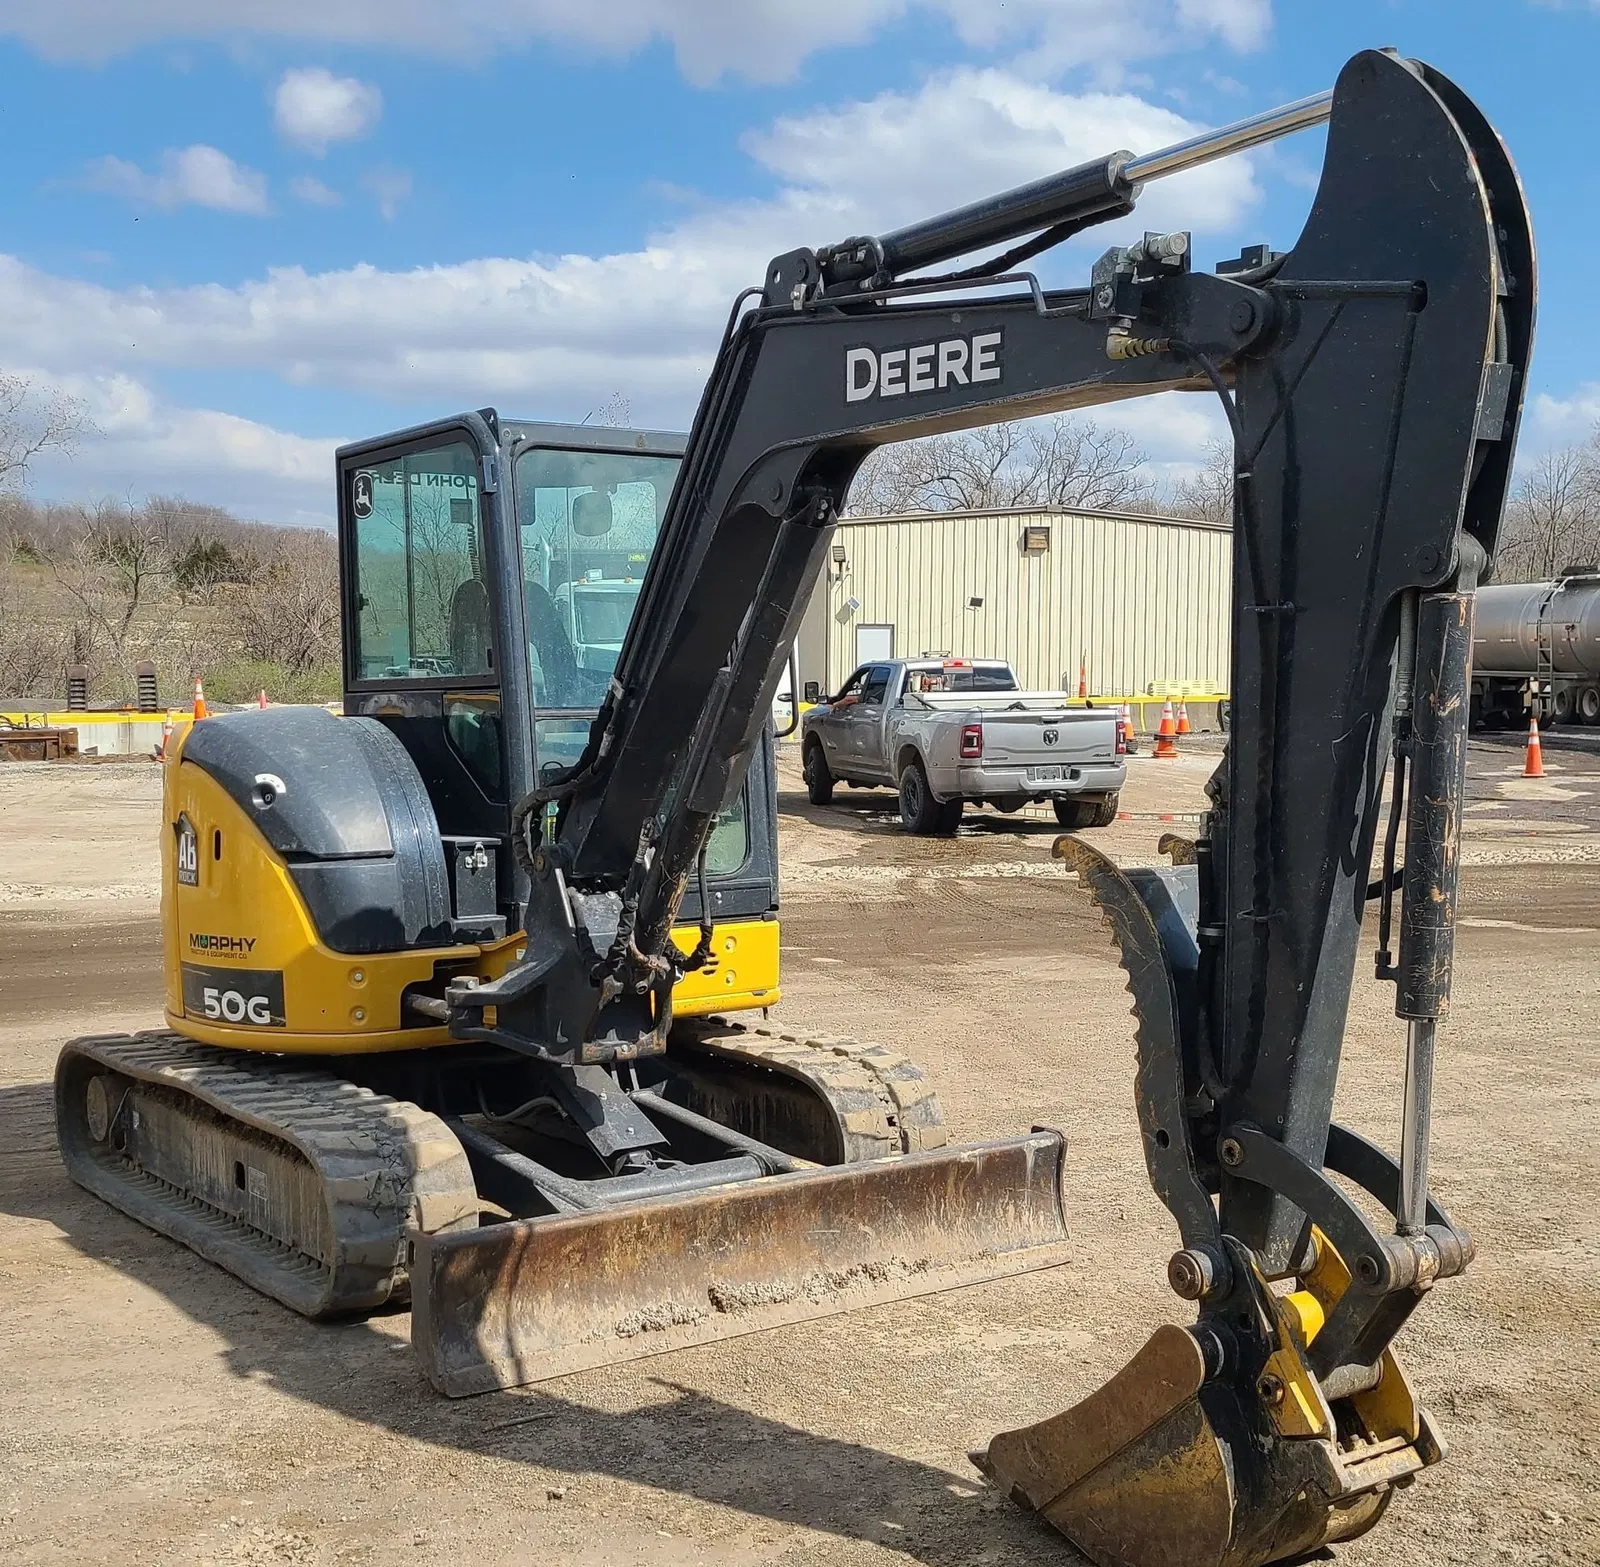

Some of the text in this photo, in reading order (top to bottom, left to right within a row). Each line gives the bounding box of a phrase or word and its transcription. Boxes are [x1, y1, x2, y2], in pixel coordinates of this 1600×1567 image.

[846, 331, 1002, 403] DEERE
[189, 932, 257, 952] MURPHY
[203, 987, 271, 1024] 50G
